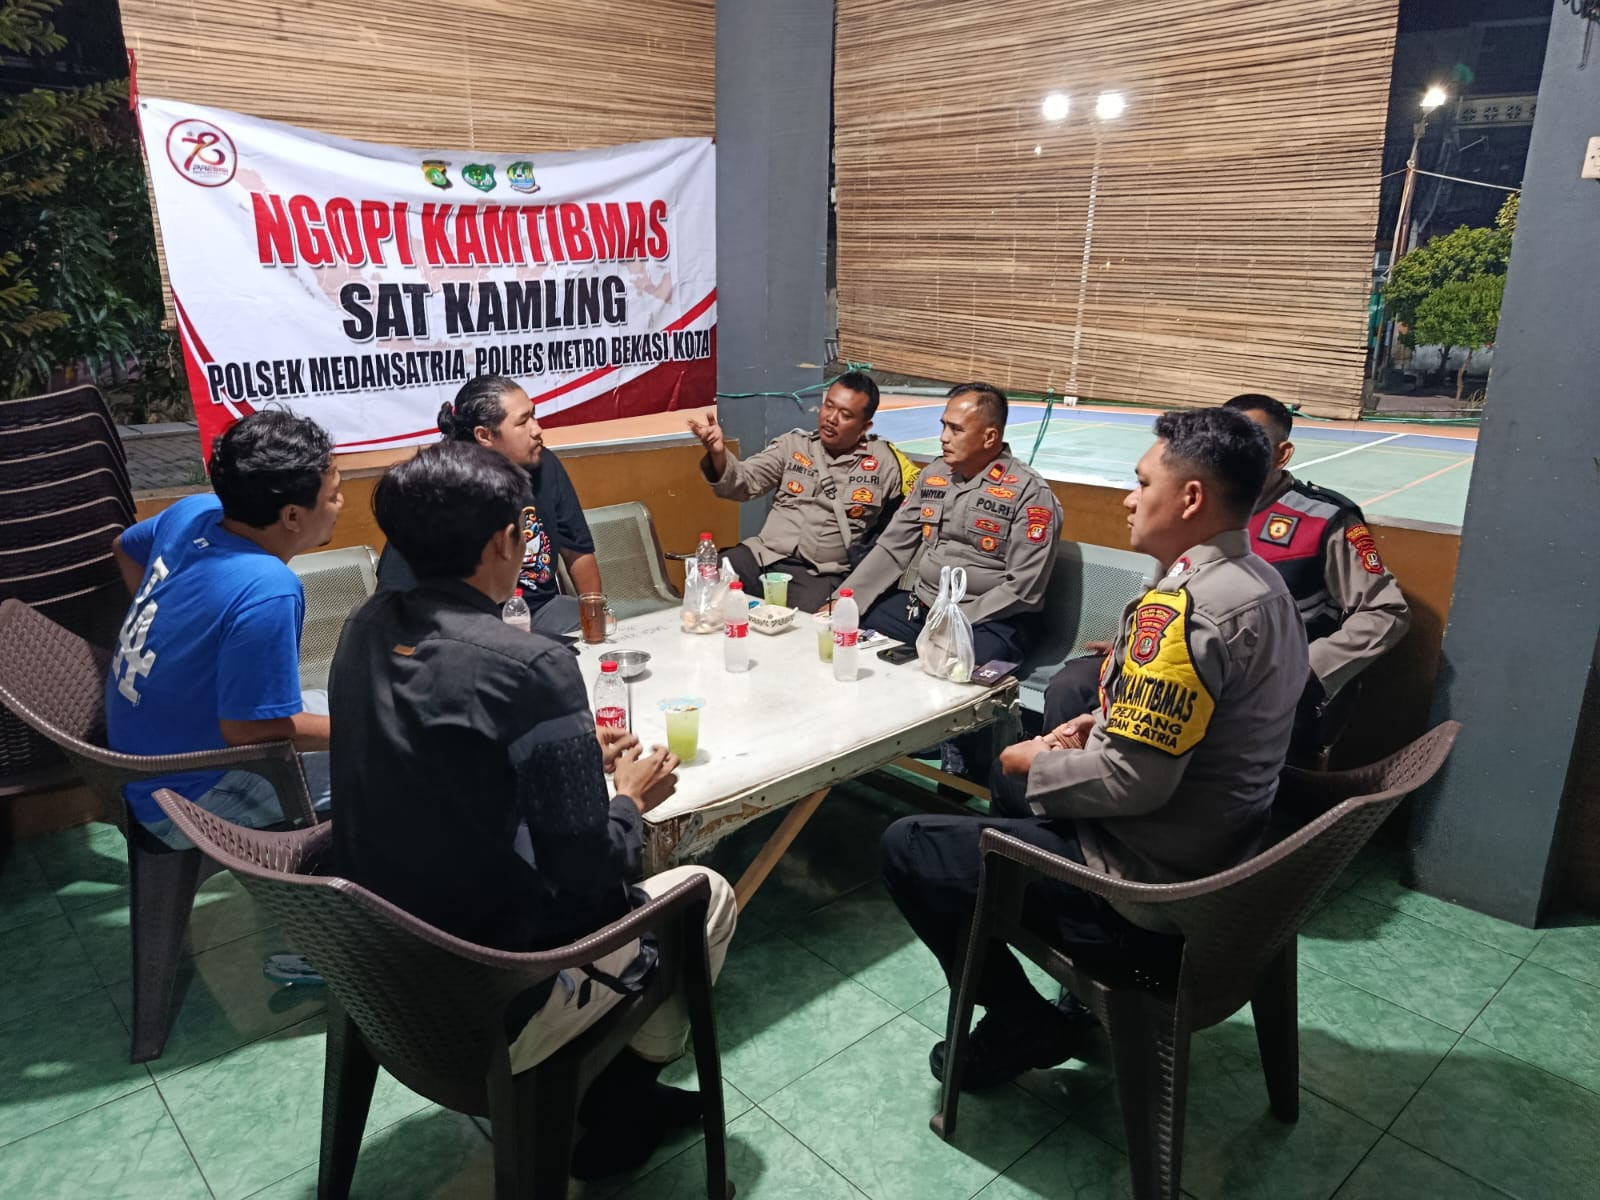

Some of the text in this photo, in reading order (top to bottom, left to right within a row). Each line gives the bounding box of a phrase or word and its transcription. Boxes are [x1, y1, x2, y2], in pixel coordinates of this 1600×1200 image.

[251, 192, 670, 267] NGOPI KAMTIBMAS
[339, 275, 627, 342] SAT KAMLING
[207, 329, 711, 401] POLSEK MEDANSATRIA, POLRES METRO BEKASI KOTA
[848, 475, 880, 485] POLRI
[976, 497, 1011, 516] POLRI
[1112, 707, 1183, 736] PEJUANG
[1132, 723, 1178, 750] SATRIA
